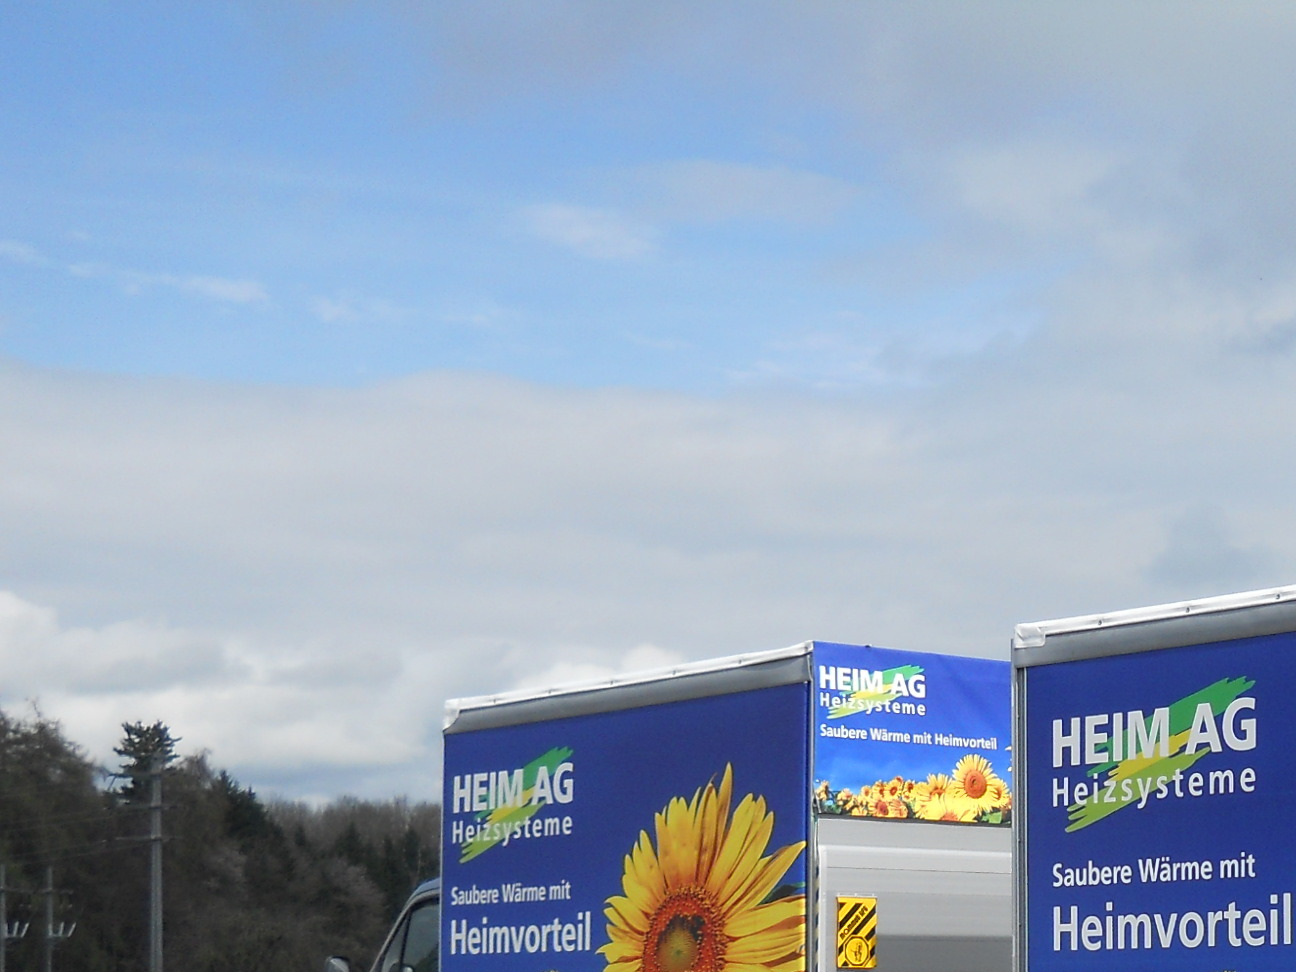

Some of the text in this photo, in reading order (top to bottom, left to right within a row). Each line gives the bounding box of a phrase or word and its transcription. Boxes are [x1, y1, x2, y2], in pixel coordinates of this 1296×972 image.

[819, 665, 926, 699] HEIM AG
[820, 692, 926, 716] Heizsysteme
[819, 723, 998, 750] Saubere Wärme mit Heimvorteil
[1052, 696, 1258, 768] HEIM AG
[453, 762, 574, 814] HEIM AG
[1052, 766, 1257, 810] Heizsysteme
[452, 815, 573, 847] Heizsysteme
[1052, 851, 1256, 888] Saubere Wärme mit
[451, 879, 571, 906] Saubere Wärme mit
[450, 911, 591, 955] Heimvorteil
[1052, 892, 1293, 952] Heimvorteil
